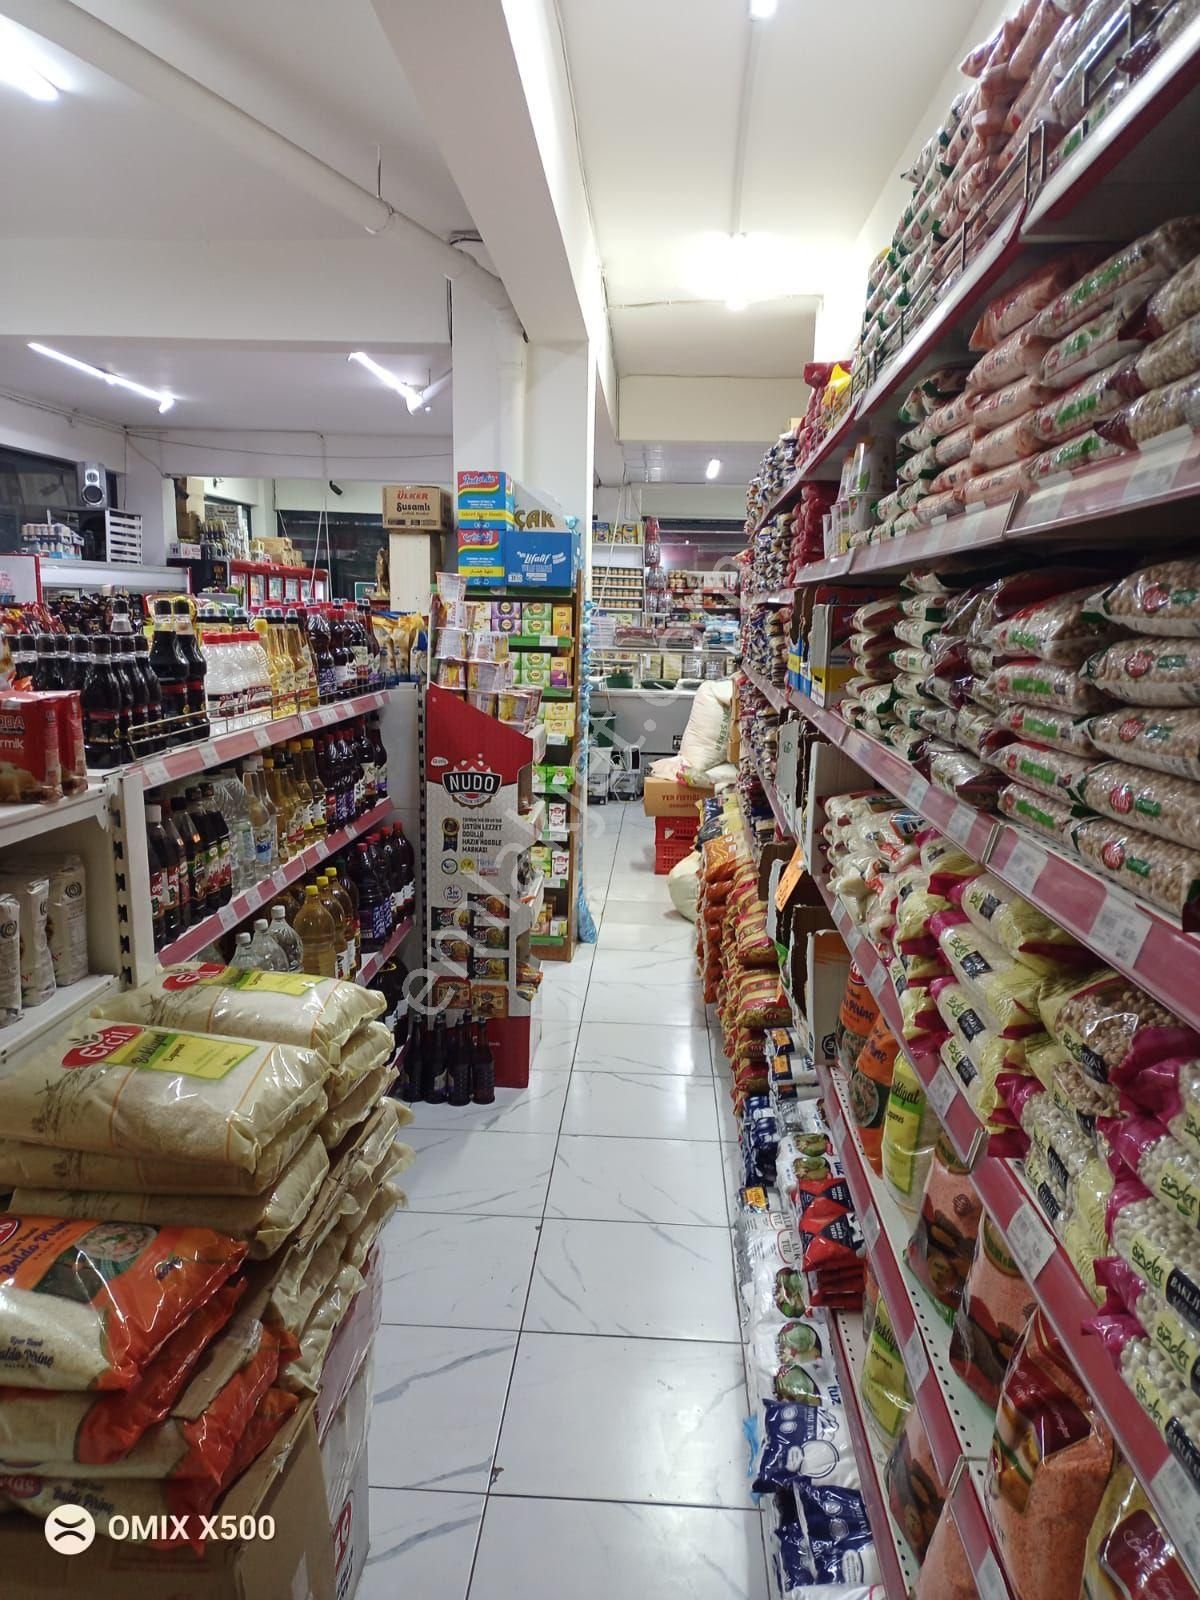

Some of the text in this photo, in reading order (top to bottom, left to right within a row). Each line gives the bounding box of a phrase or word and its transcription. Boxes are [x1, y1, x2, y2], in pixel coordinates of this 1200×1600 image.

[396, 502, 431, 513] Susamlı
[0, 739, 24, 750] rmik
[449, 774, 495, 792] NUDO
[836, 1223, 844, 1239] SOFRA
